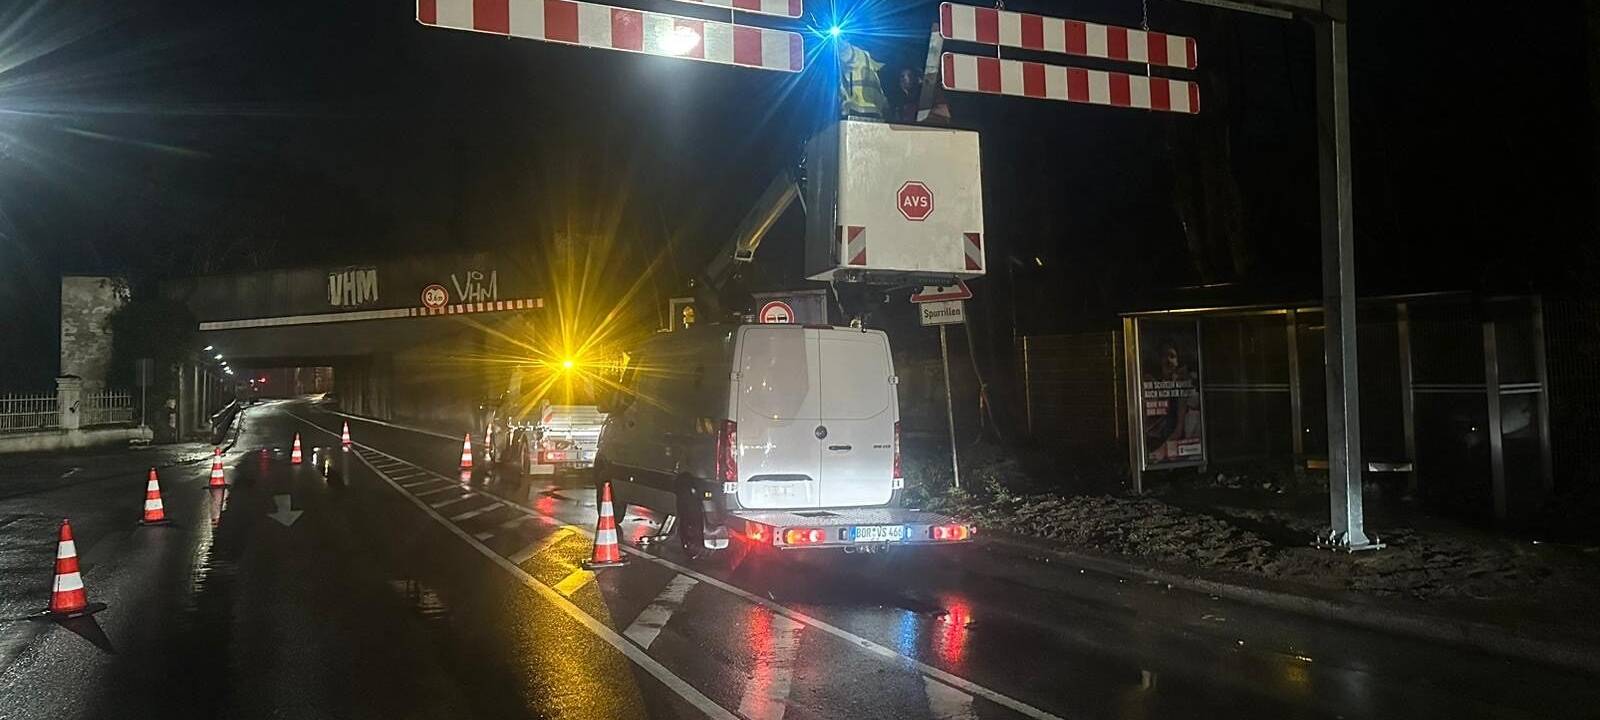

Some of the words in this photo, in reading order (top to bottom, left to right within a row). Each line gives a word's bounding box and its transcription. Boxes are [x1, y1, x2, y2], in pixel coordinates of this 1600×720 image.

[903, 195, 928, 207] AVS
[328, 269, 378, 306] VHM
[923, 307, 961, 320] Spurrillen
[856, 527, 871, 538] BOR
[877, 526, 887, 537] VS
